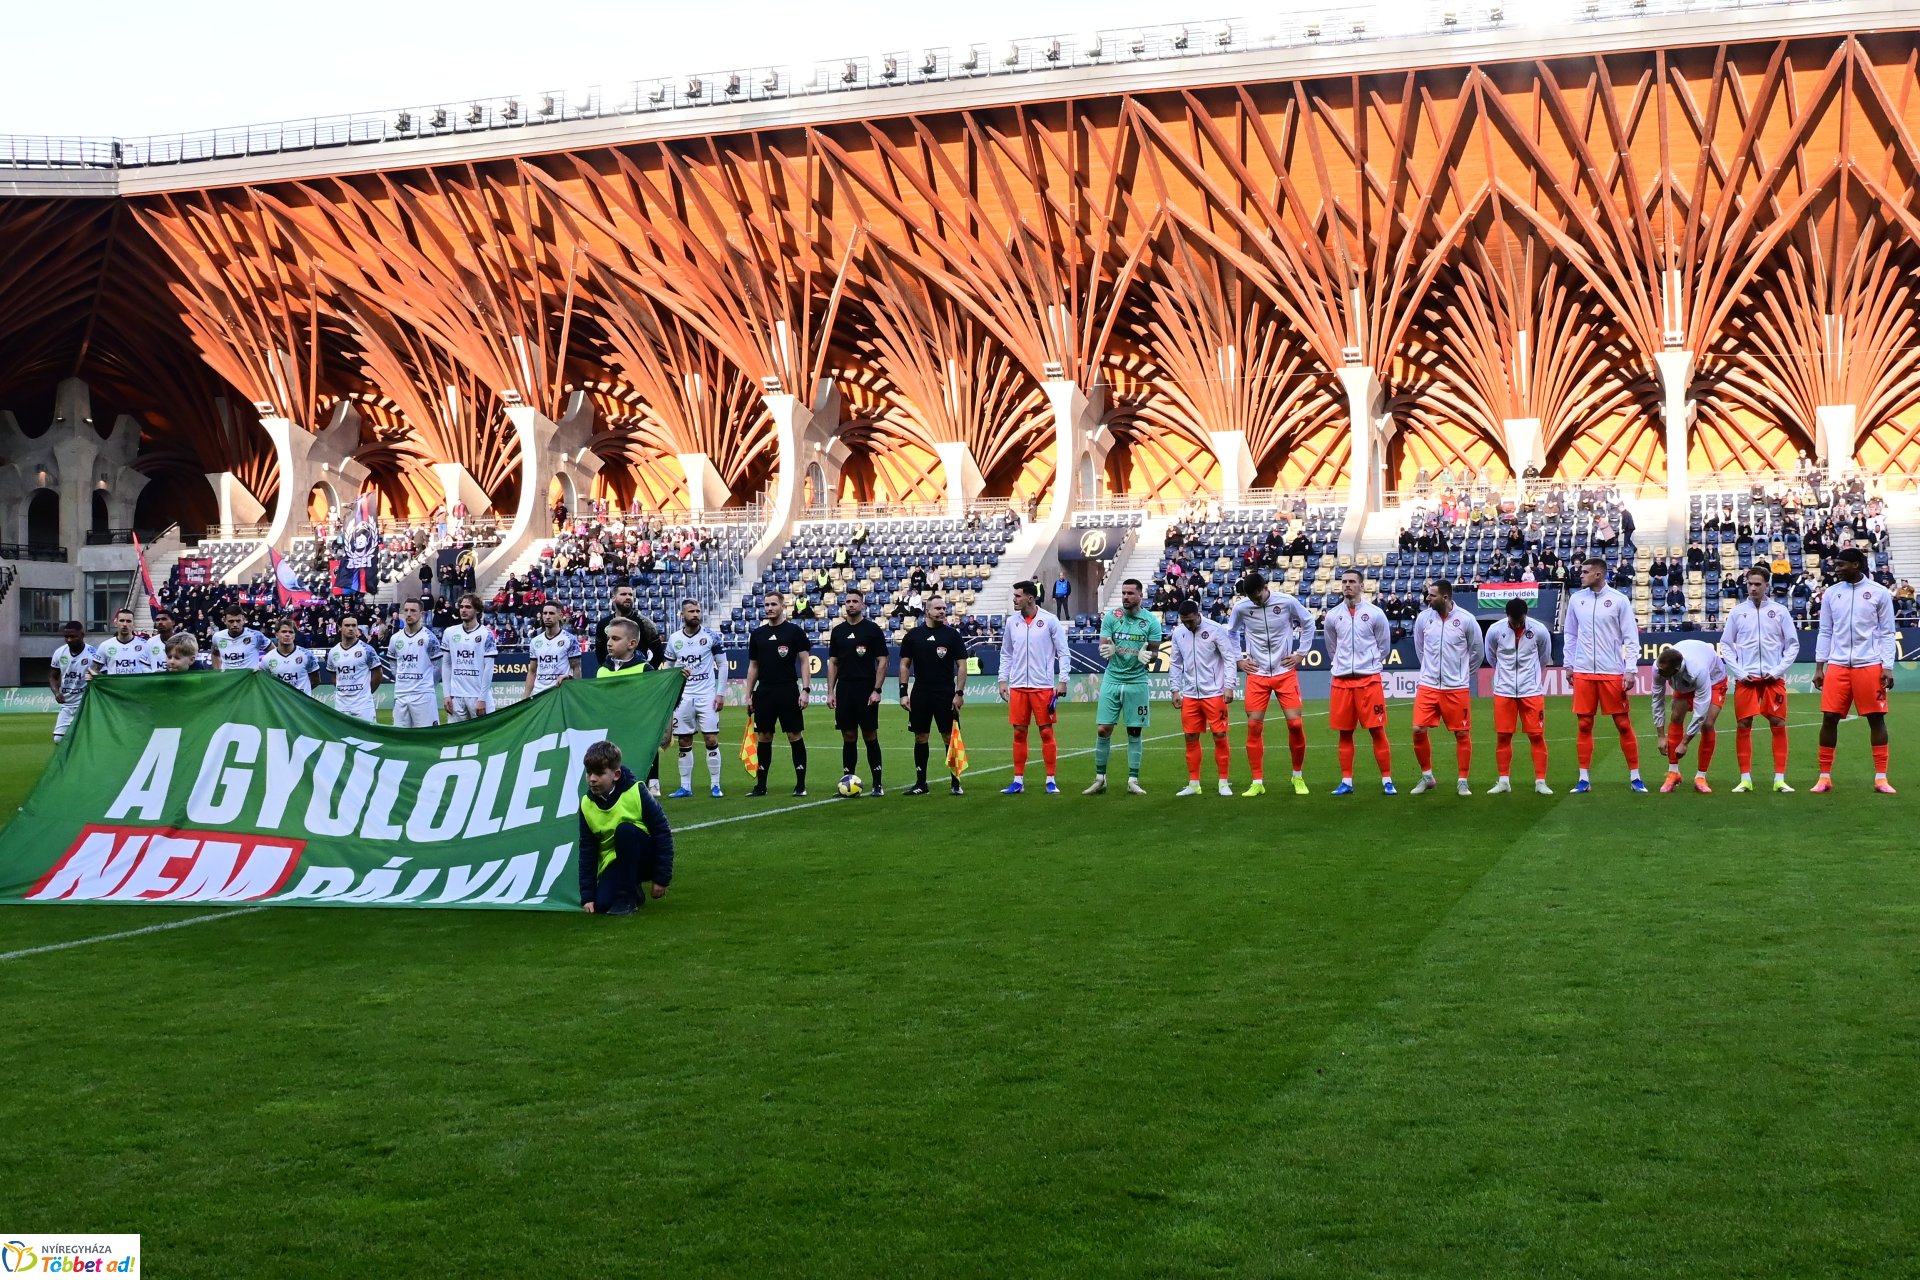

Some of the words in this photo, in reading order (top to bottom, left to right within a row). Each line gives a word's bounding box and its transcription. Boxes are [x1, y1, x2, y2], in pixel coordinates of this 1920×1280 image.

[1480, 590, 1496, 598] Bart
[1138, 706, 1148, 716] 63
[1374, 704, 1384, 715] 98
[1539, 710, 1544, 721] 6
[104, 727, 182, 821] A
[187, 722, 608, 843] GYŰLÖLET
[26, 832, 293, 901] NEM
